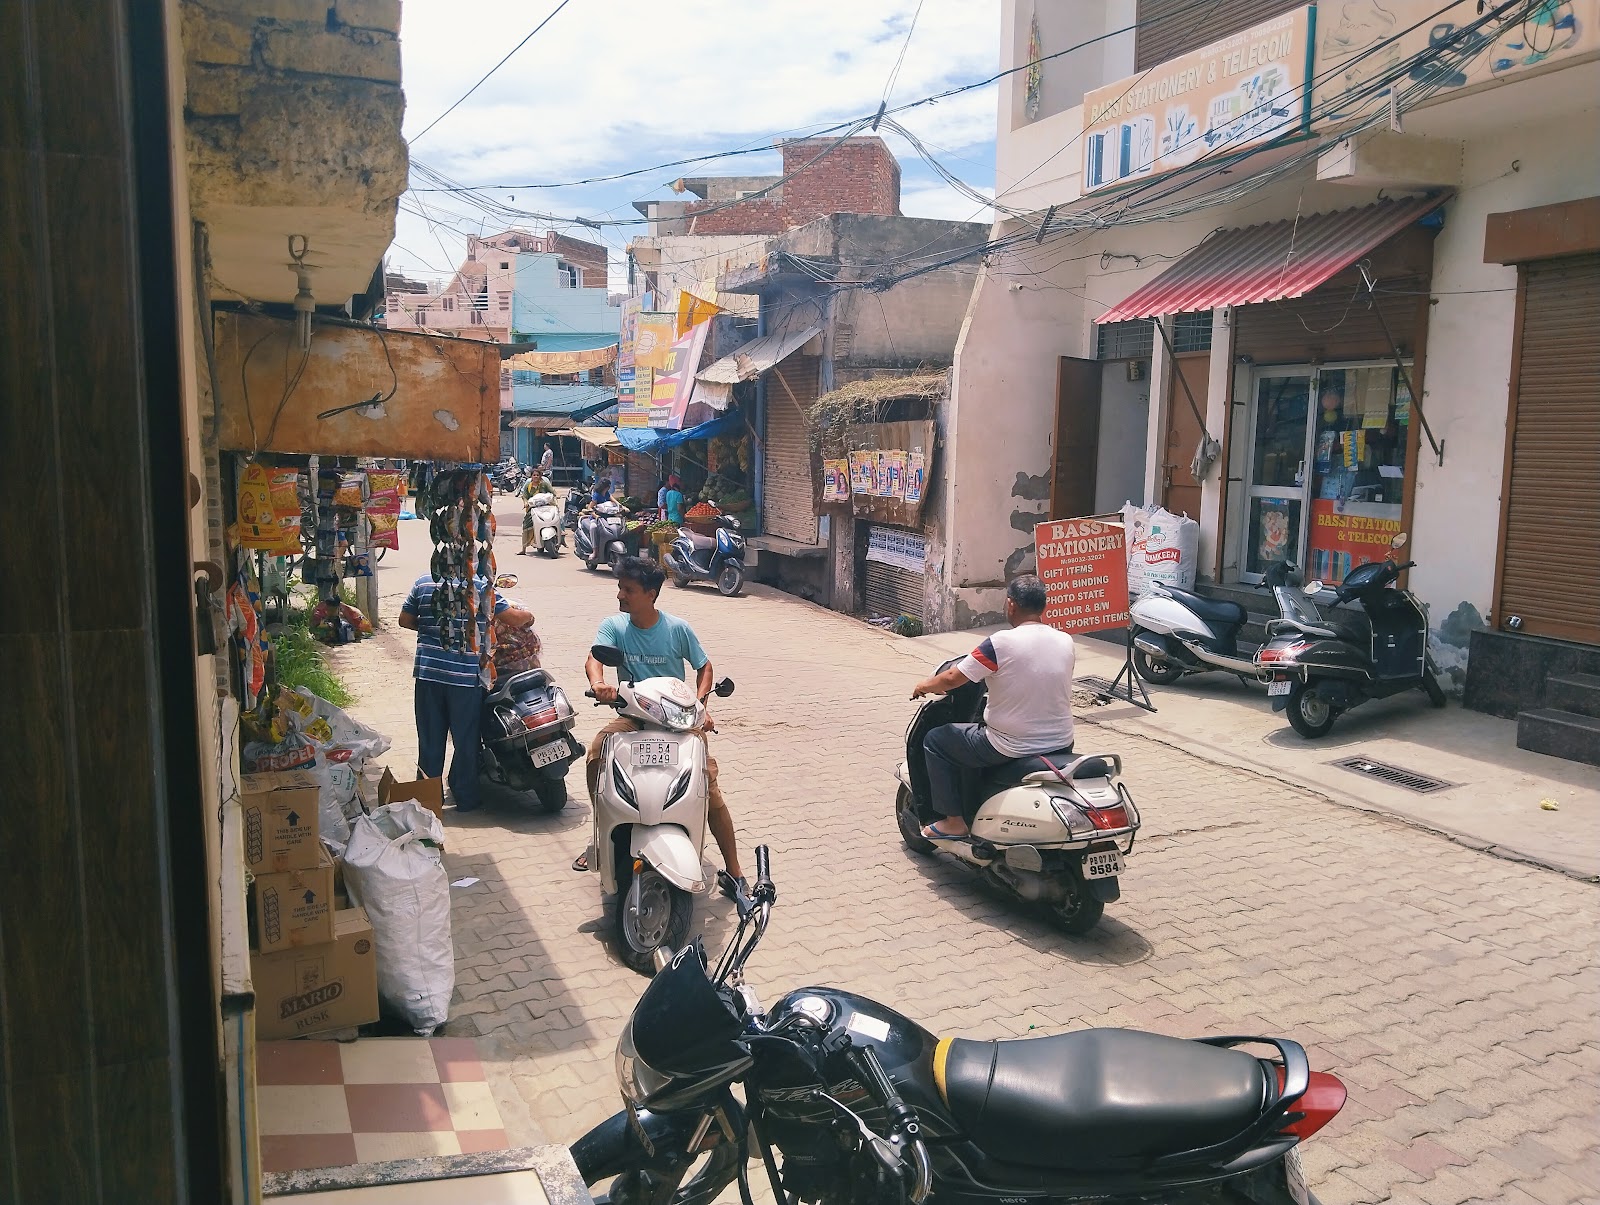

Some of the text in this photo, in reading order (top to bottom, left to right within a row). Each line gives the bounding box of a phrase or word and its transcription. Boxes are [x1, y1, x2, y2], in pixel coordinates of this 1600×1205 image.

[1091, 31, 1293, 125] BASSI STATIONERY & TELECOM
[1051, 521, 1110, 540] BASSI
[1318, 515, 1401, 532] BASSI STATION
[1338, 530, 1346, 540] &
[1039, 534, 1124, 559] STATIONERY
[1044, 564, 1094, 578] GIFT ITEMS
[1045, 575, 1109, 592] BOOK BINDING
[1046, 589, 1104, 605] PHOTO STATE
[1046, 601, 1110, 618] COLOUR & B/W
[1066, 616, 1100, 629] SPORTS
[1103, 612, 1129, 624] ITEMS
[640, 743, 670, 753] PB 54
[260, 745, 314, 771] PROPEL
[540, 750, 566, 765] 3142
[640, 755, 670, 764] G7849
[1002, 820, 1038, 828] Activa
[1090, 854, 1116, 865] PB 07 AU
[1090, 862, 1118, 875] 9584
[282, 984, 341, 1017] MARIO
[296, 1010, 329, 1029] RUSK
